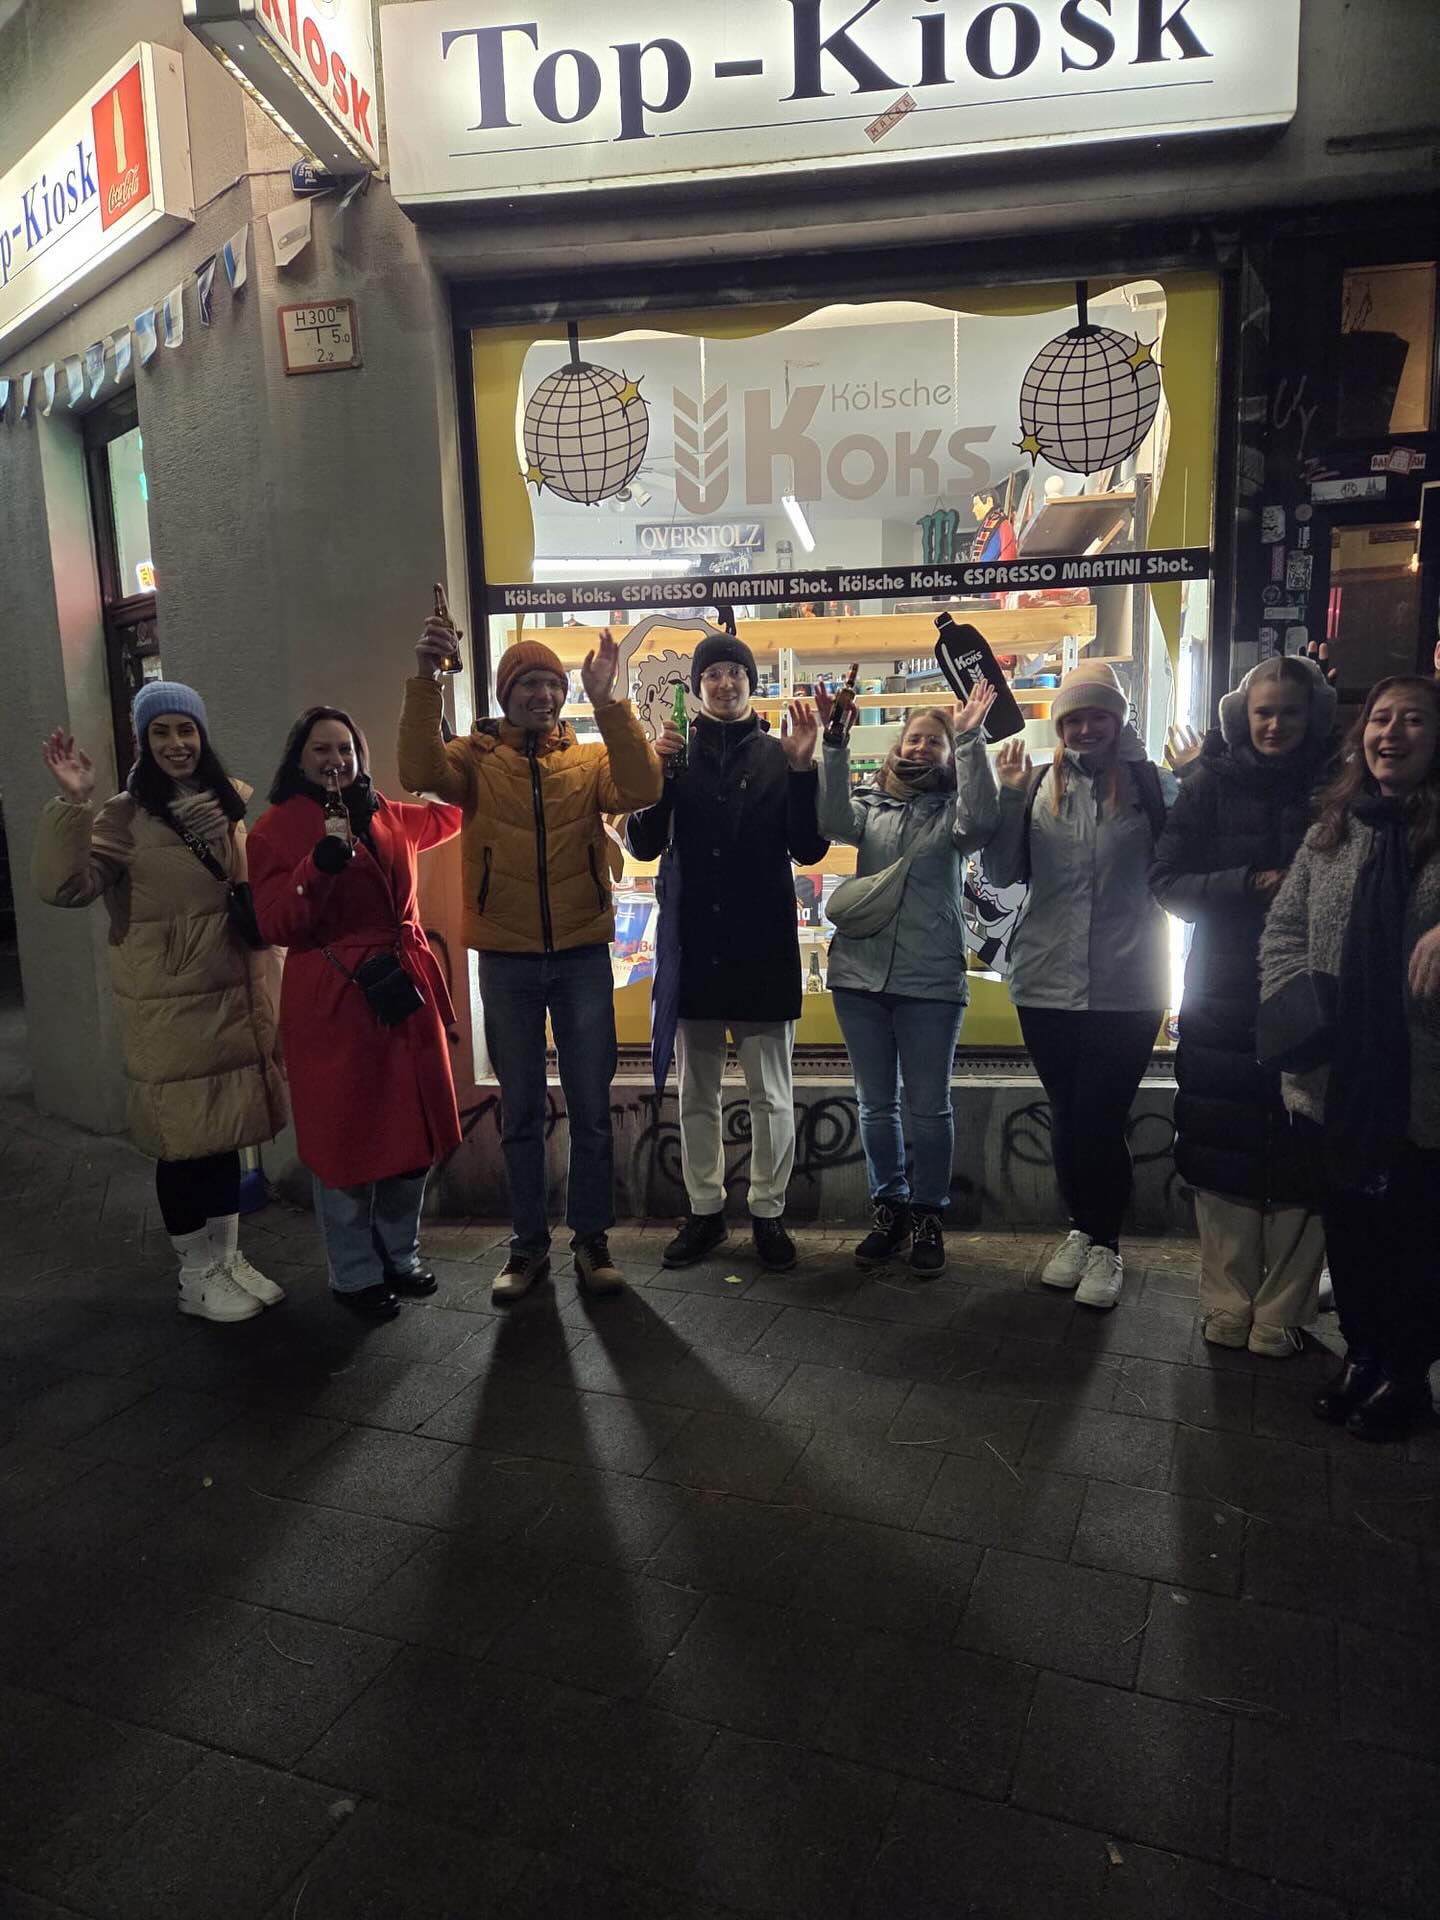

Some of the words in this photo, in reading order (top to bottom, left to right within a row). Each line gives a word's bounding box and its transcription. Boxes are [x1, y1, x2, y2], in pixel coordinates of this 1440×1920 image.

[441, 0, 1215, 141] Top-Kiosk
[296, 308, 336, 326] H300
[831, 378, 952, 412] Kölsche
[639, 523, 762, 550] OVERSTOLZ
[504, 590, 567, 607] Kölsche
[572, 586, 616, 604] Koks.
[621, 582, 708, 601] ESPRESSO
[712, 578, 785, 598] MARTINI
[789, 577, 833, 595] Shot.
[838, 573, 905, 592] Kölsche
[910, 570, 958, 589] Koks.
[963, 563, 1057, 586] ESPRESSO
[1061, 558, 1141, 580] MARTINI
[1146, 555, 1195, 575] Shot.
